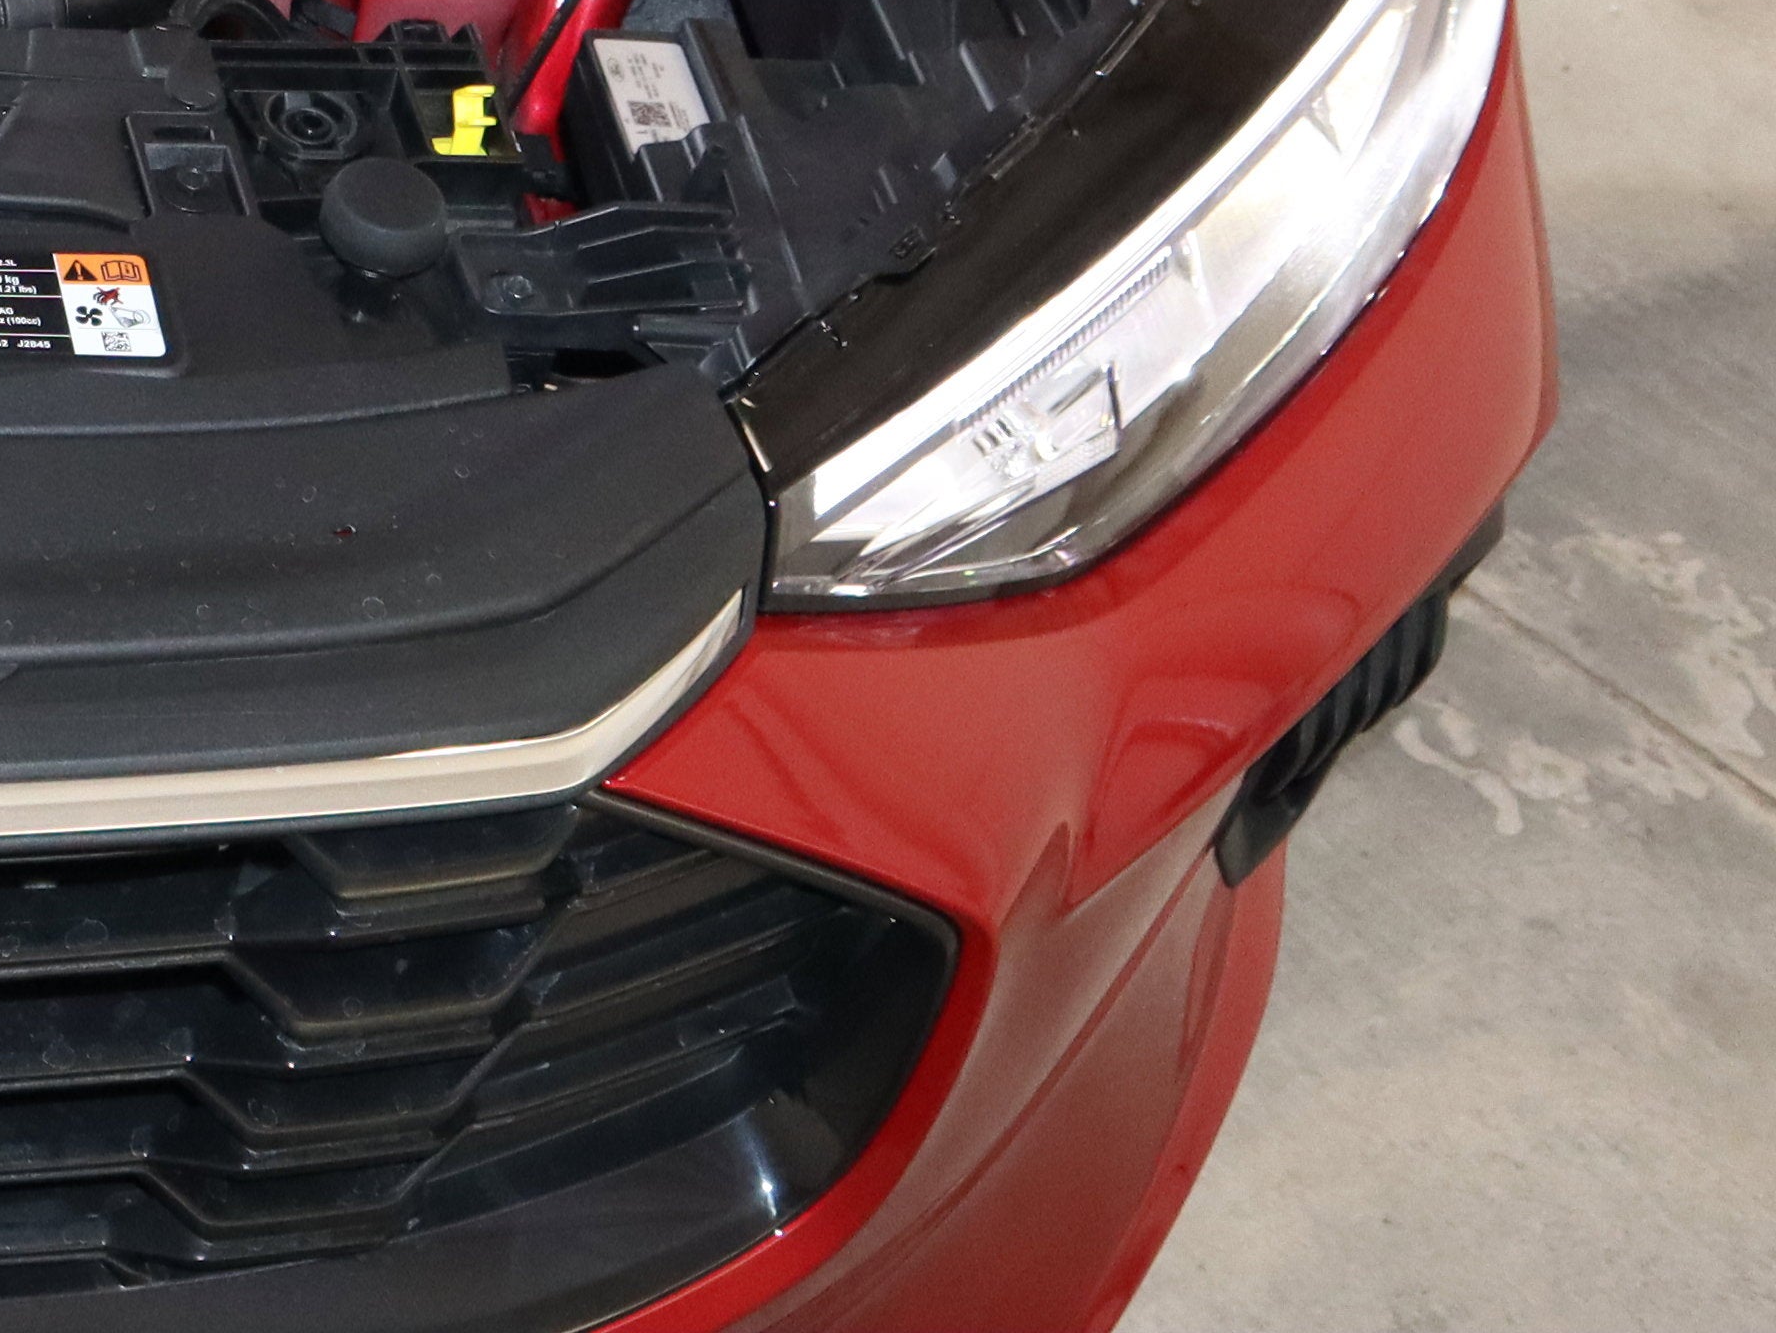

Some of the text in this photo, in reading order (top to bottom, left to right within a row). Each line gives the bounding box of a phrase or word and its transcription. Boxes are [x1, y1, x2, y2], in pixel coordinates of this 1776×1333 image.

[4, 275, 20, 286] kg
[18, 285, 37, 294] lbs)
[6, 316, 42, 327] (100cc)
